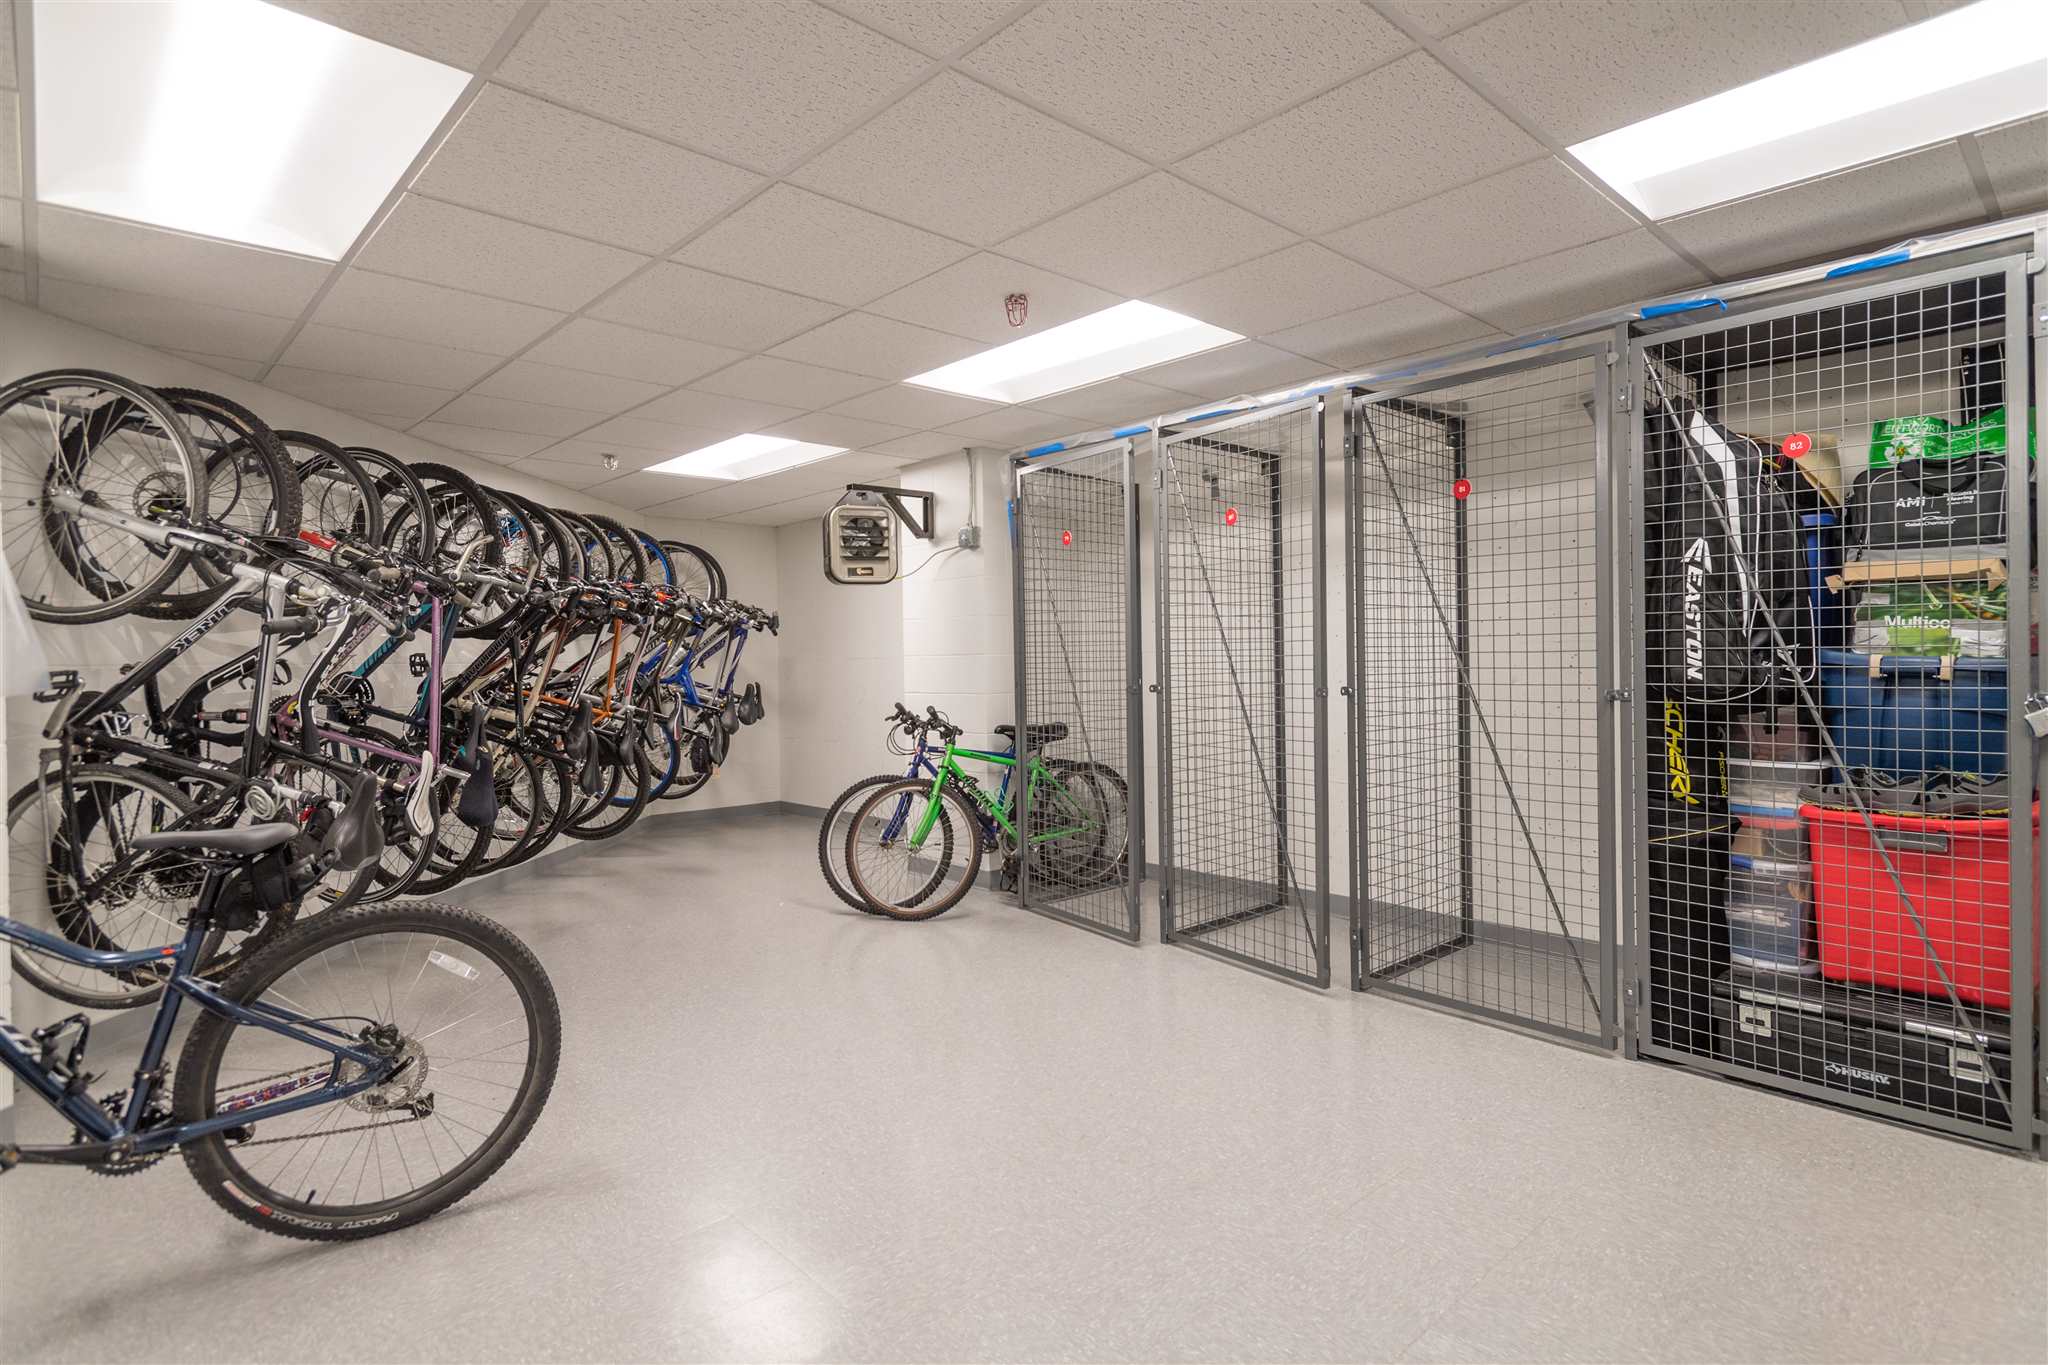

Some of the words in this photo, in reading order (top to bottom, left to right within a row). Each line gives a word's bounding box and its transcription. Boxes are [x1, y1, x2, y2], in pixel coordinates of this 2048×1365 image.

[1790, 441, 1803, 451] 82
[1895, 496, 1926, 509] AMI
[169, 604, 235, 656] TREK
[1684, 564, 1704, 681] EASTON
